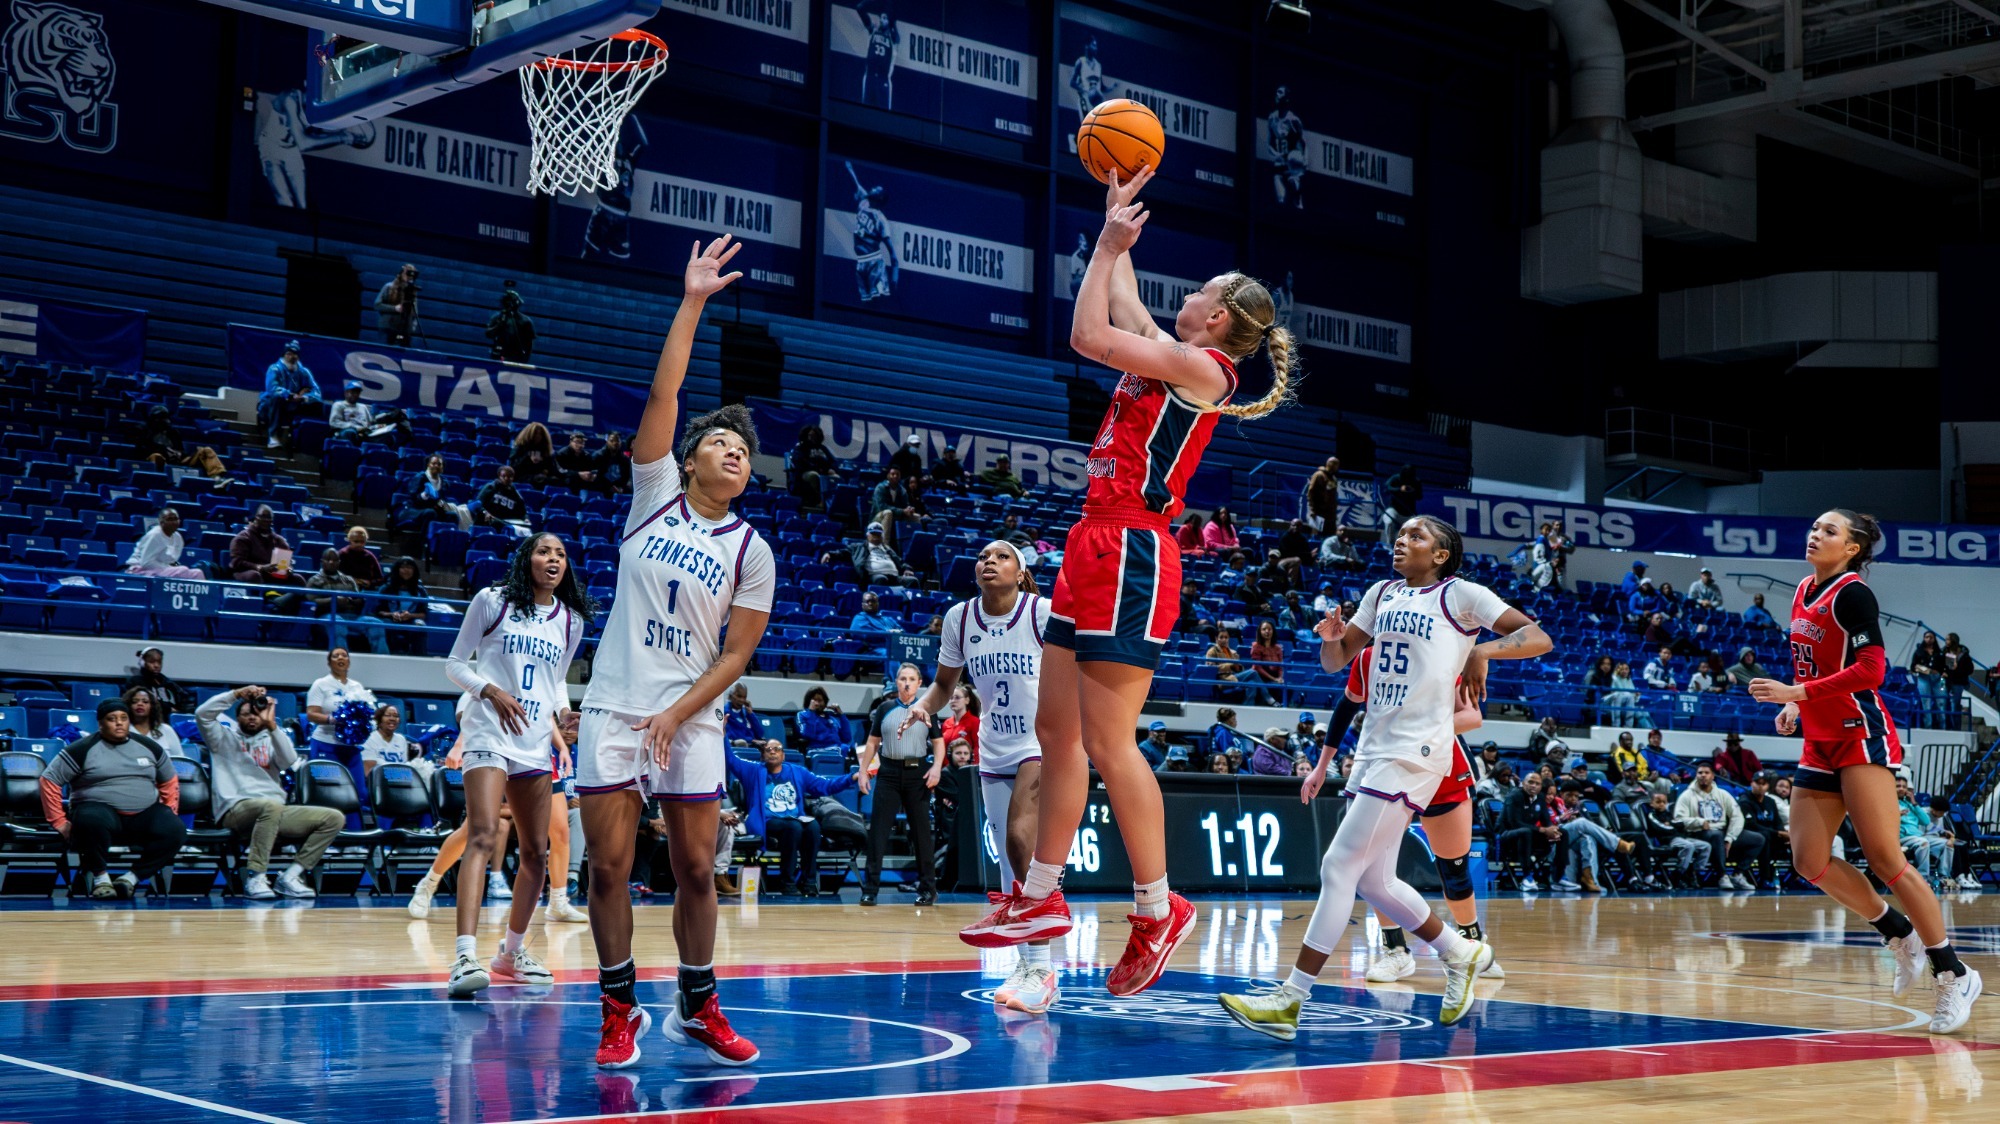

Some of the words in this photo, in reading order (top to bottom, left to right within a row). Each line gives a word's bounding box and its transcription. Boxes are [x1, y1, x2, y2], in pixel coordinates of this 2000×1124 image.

[909, 33, 952, 70] ROBERT
[958, 46, 1020, 87] COVINGTON
[1174, 102, 1209, 140] SWIFT
[385, 125, 427, 170] DICK
[437, 136, 518, 187] BARNETT
[1322, 141, 1340, 172] TED
[1345, 147, 1388, 184] McCLAIN
[650, 181, 717, 223] ANTHONY
[724, 195, 773, 234] MASON
[903, 231, 952, 270] CARLOS
[958, 242, 1004, 280] ROGERS
[1306, 312, 1350, 346] CAROLYN
[1354, 322, 1399, 356] ALDRIDGE
[344, 351, 594, 427] STATE
[819, 414, 1090, 490] UNIVERS
[1443, 496, 1636, 548] TIGERS
[1897, 529, 1987, 561] BIG
[639, 535, 726, 597] TENNESSEE
[163, 581, 209, 595] SECTION
[667, 579, 680, 614] 1
[644, 619, 692, 657] STATE
[899, 635, 930, 647] SECTION
[905, 646, 923, 660] P-1
[522, 663, 535, 690] 0
[970, 652, 1034, 678] TENNESSEE
[1378, 641, 1410, 674] 55
[512, 696, 541, 721] ATE
[996, 680, 1010, 707] 3
[1373, 683, 1409, 706] STATE
[990, 712, 1027, 734] STATE
[1100, 804, 1110, 823] 2
[1066, 827, 1101, 873] 46
[1200, 811, 1284, 877] 1:12
